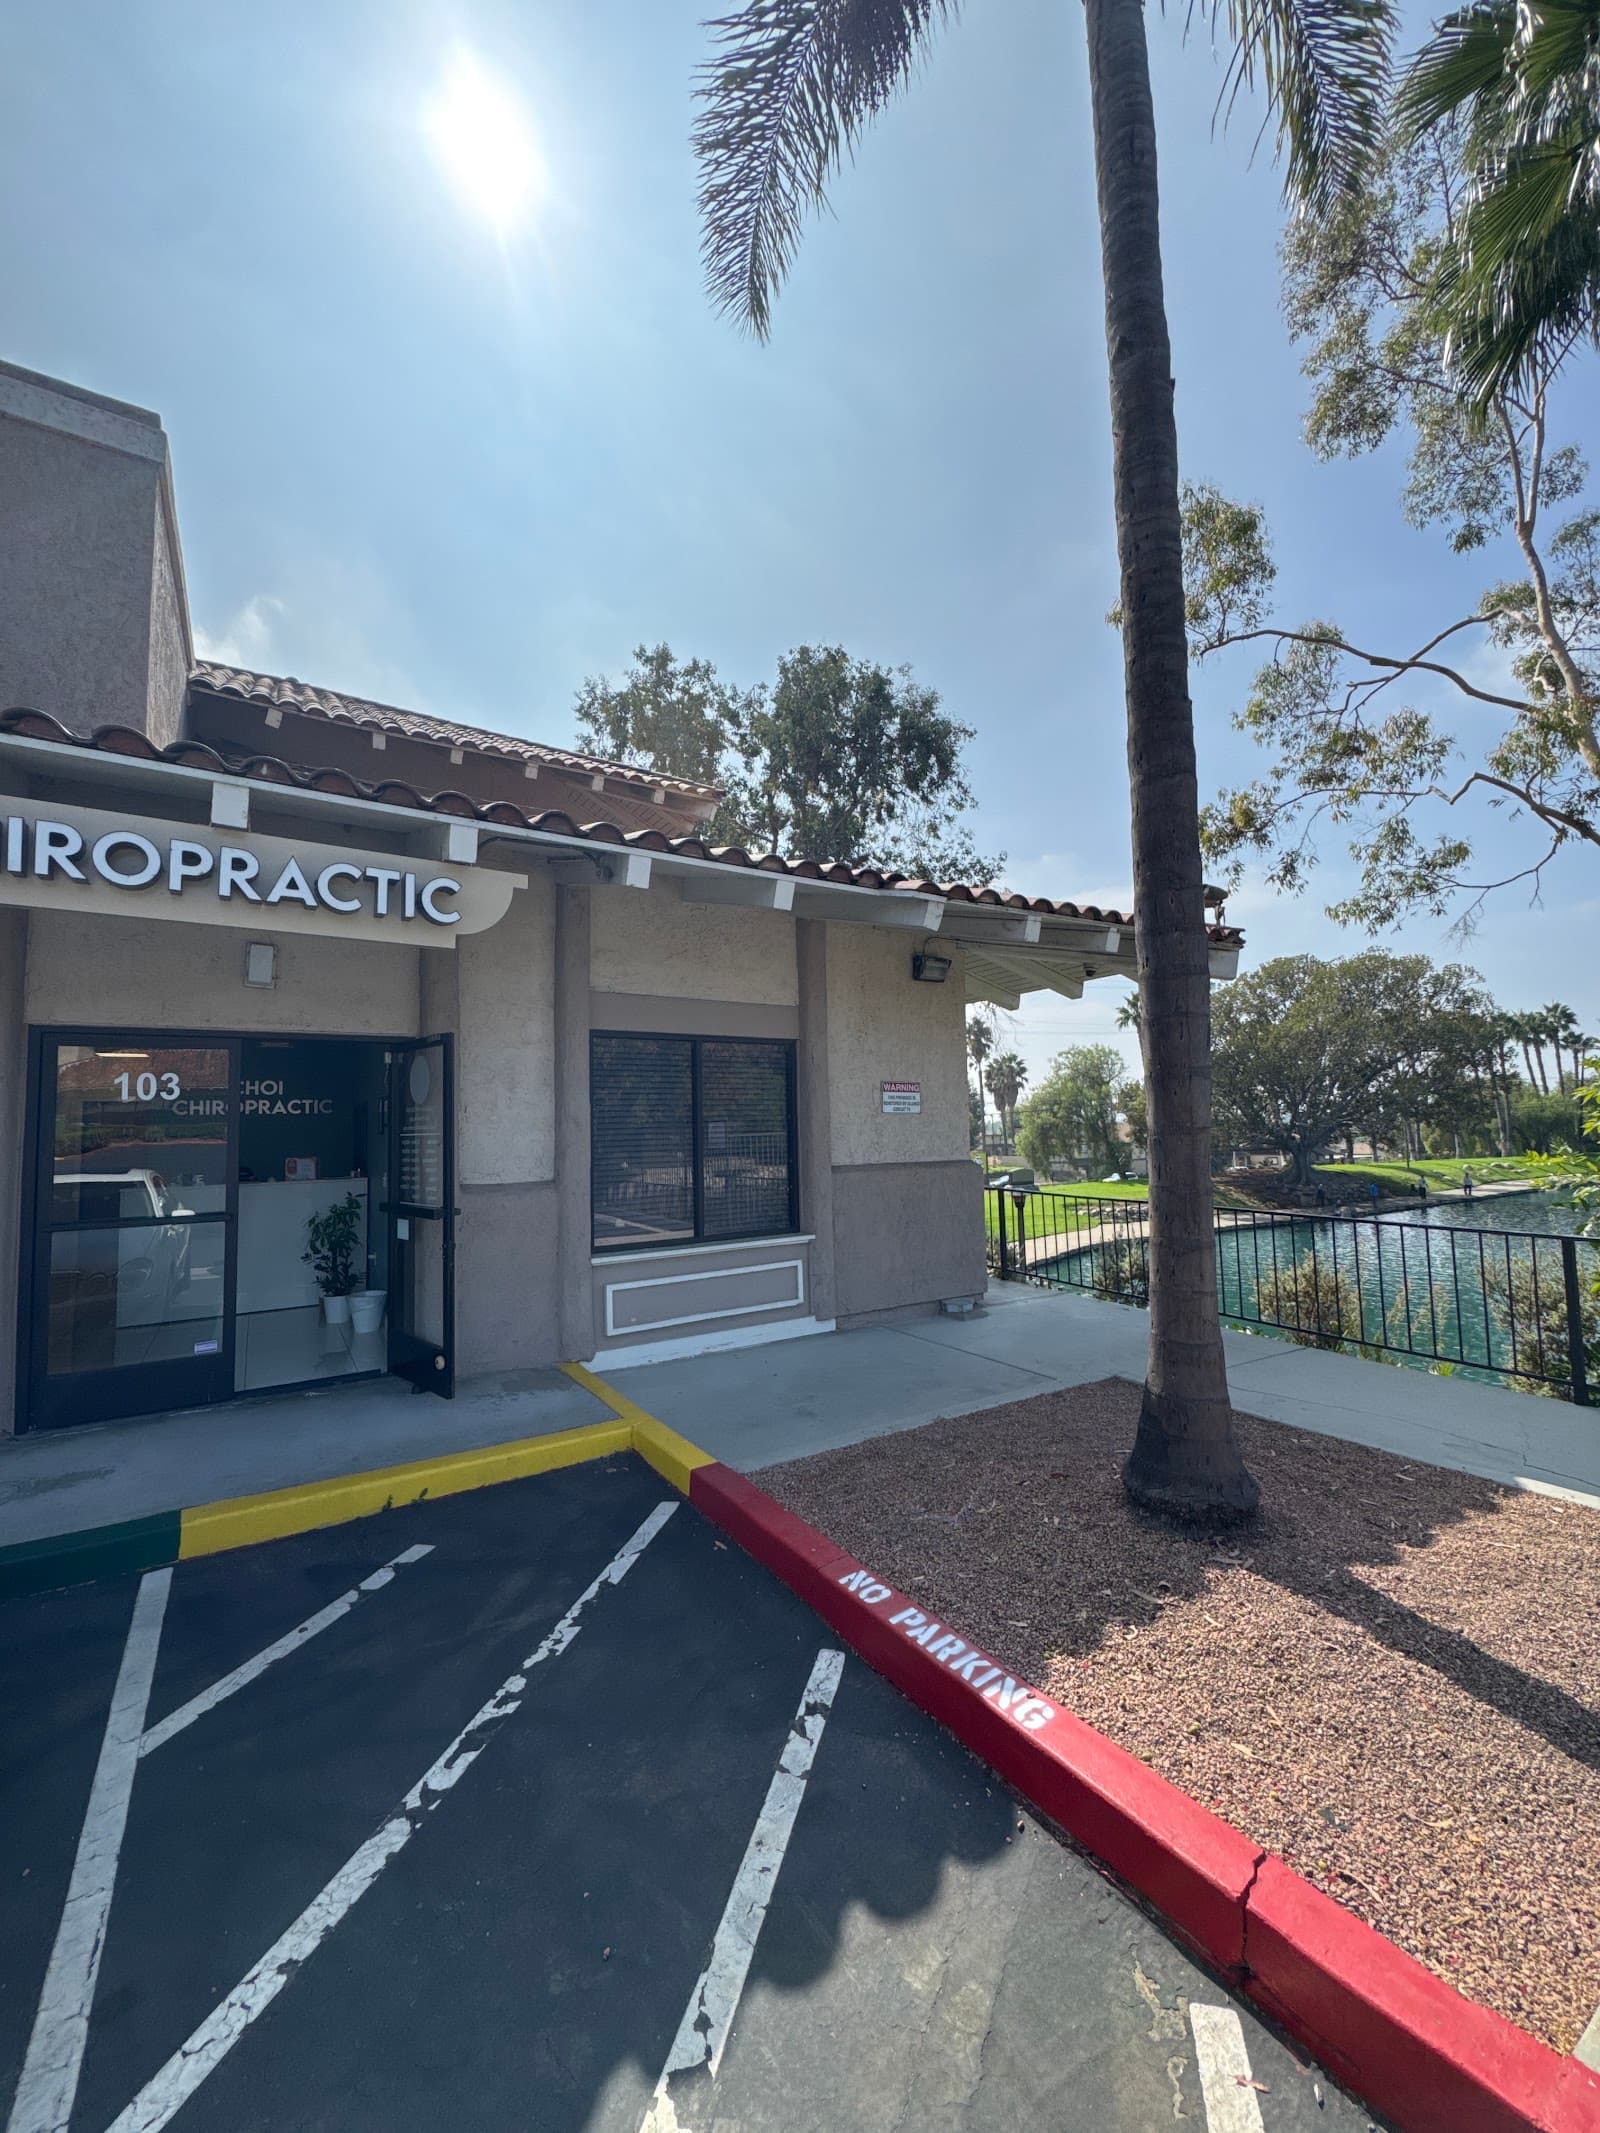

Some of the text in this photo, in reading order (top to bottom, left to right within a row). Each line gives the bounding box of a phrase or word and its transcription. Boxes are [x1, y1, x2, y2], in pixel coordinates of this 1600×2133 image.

[7, 816, 462, 924] IROPRACTIC
[114, 1072, 181, 1102] 103
[883, 1083, 920, 1092] WARNING
[838, 1570, 1055, 1729] NO PARKING
